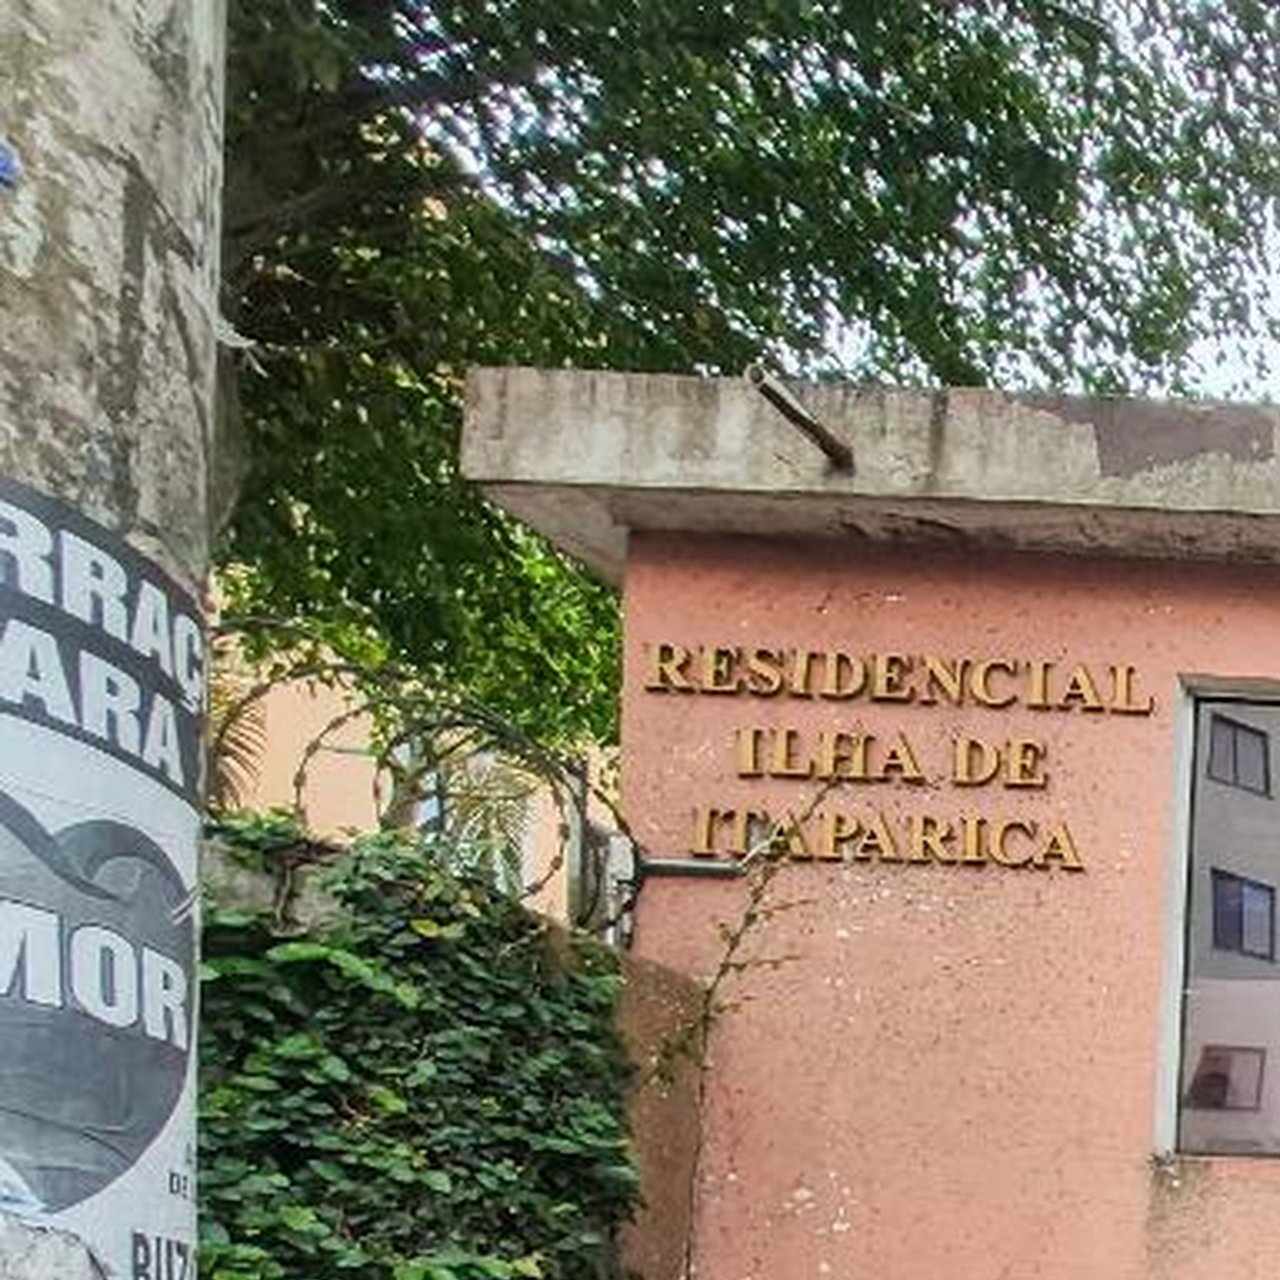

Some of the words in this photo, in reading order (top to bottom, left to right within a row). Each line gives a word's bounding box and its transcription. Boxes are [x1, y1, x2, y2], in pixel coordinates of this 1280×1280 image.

[643, 643, 1156, 716] RESIDENCIAL
[735, 727, 926, 785] ILHA
[952, 735, 1049, 790] DE
[692, 806, 1085, 871] ITAPARICA
